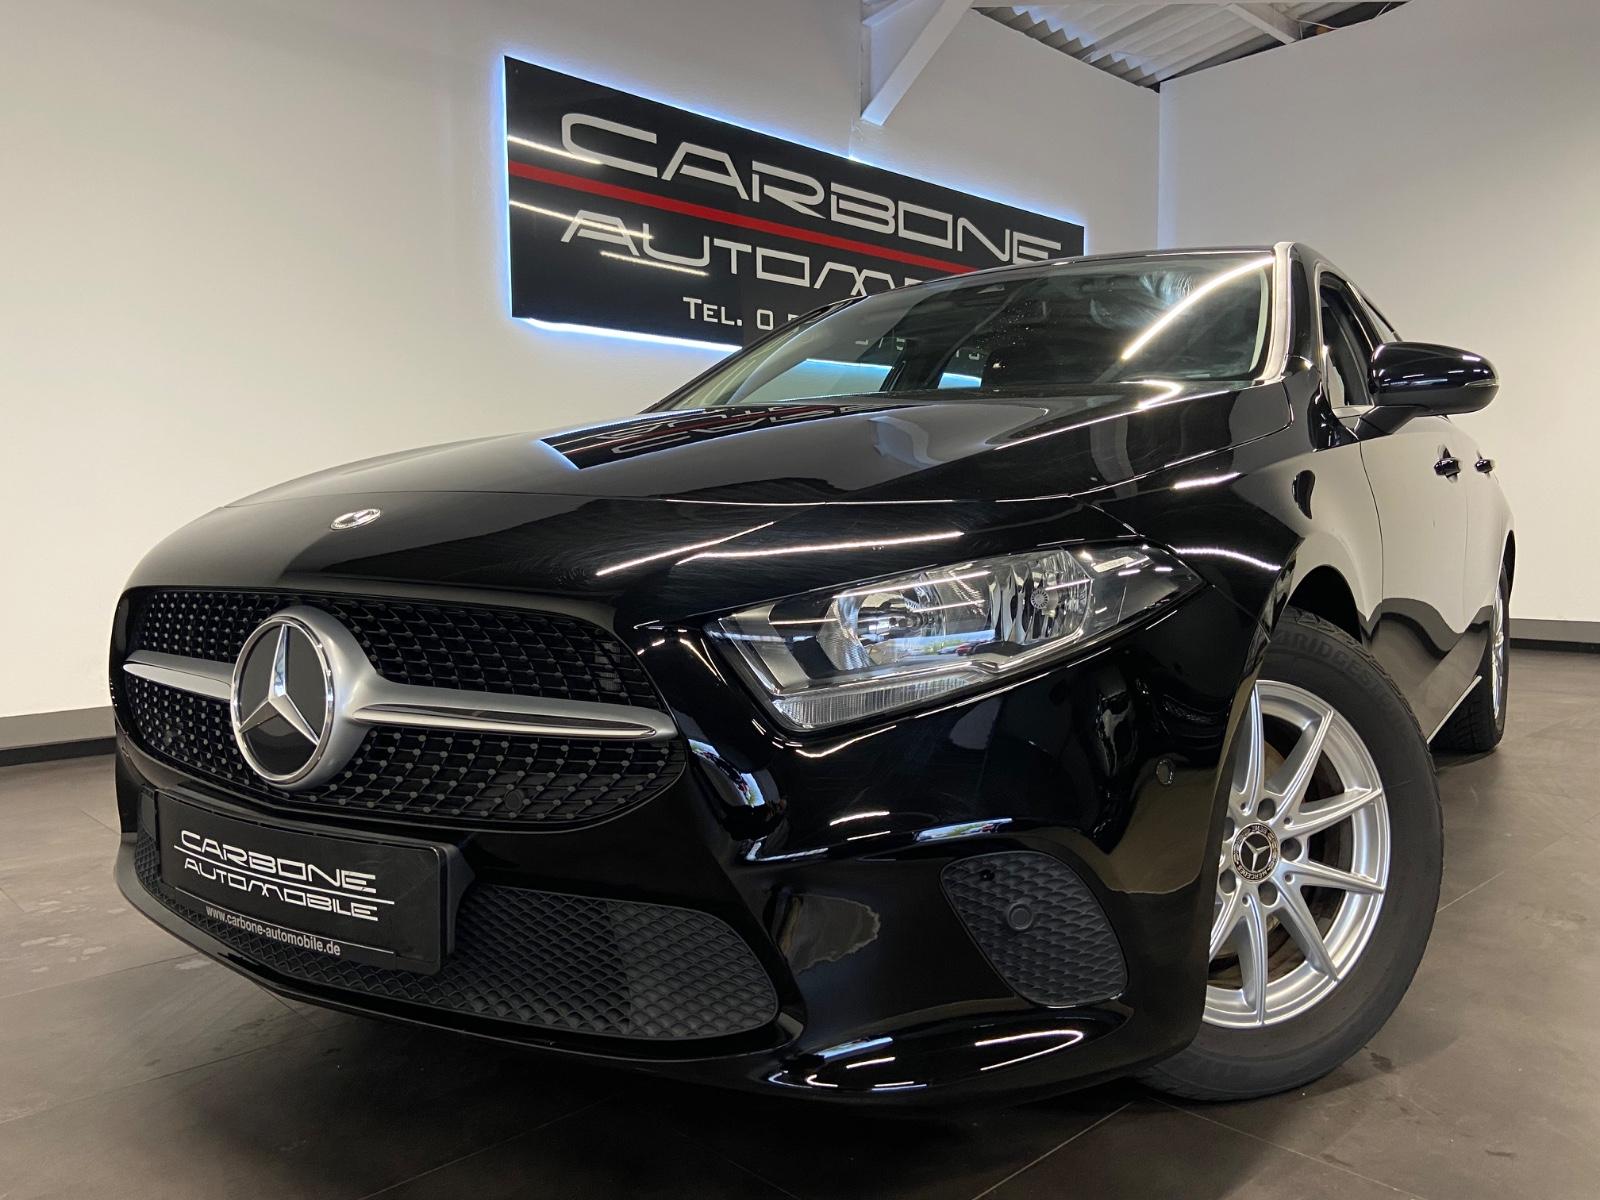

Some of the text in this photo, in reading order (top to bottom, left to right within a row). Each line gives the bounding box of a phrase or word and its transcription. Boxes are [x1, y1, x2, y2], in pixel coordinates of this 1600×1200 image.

[561, 112, 1062, 265] CARBONE
[560, 209, 923, 297] AUTOM
[181, 829, 377, 894] CARBONE
[184, 857, 379, 922] AUTOMOBILE
[205, 905, 341, 956] www.carbone-automobile.de
